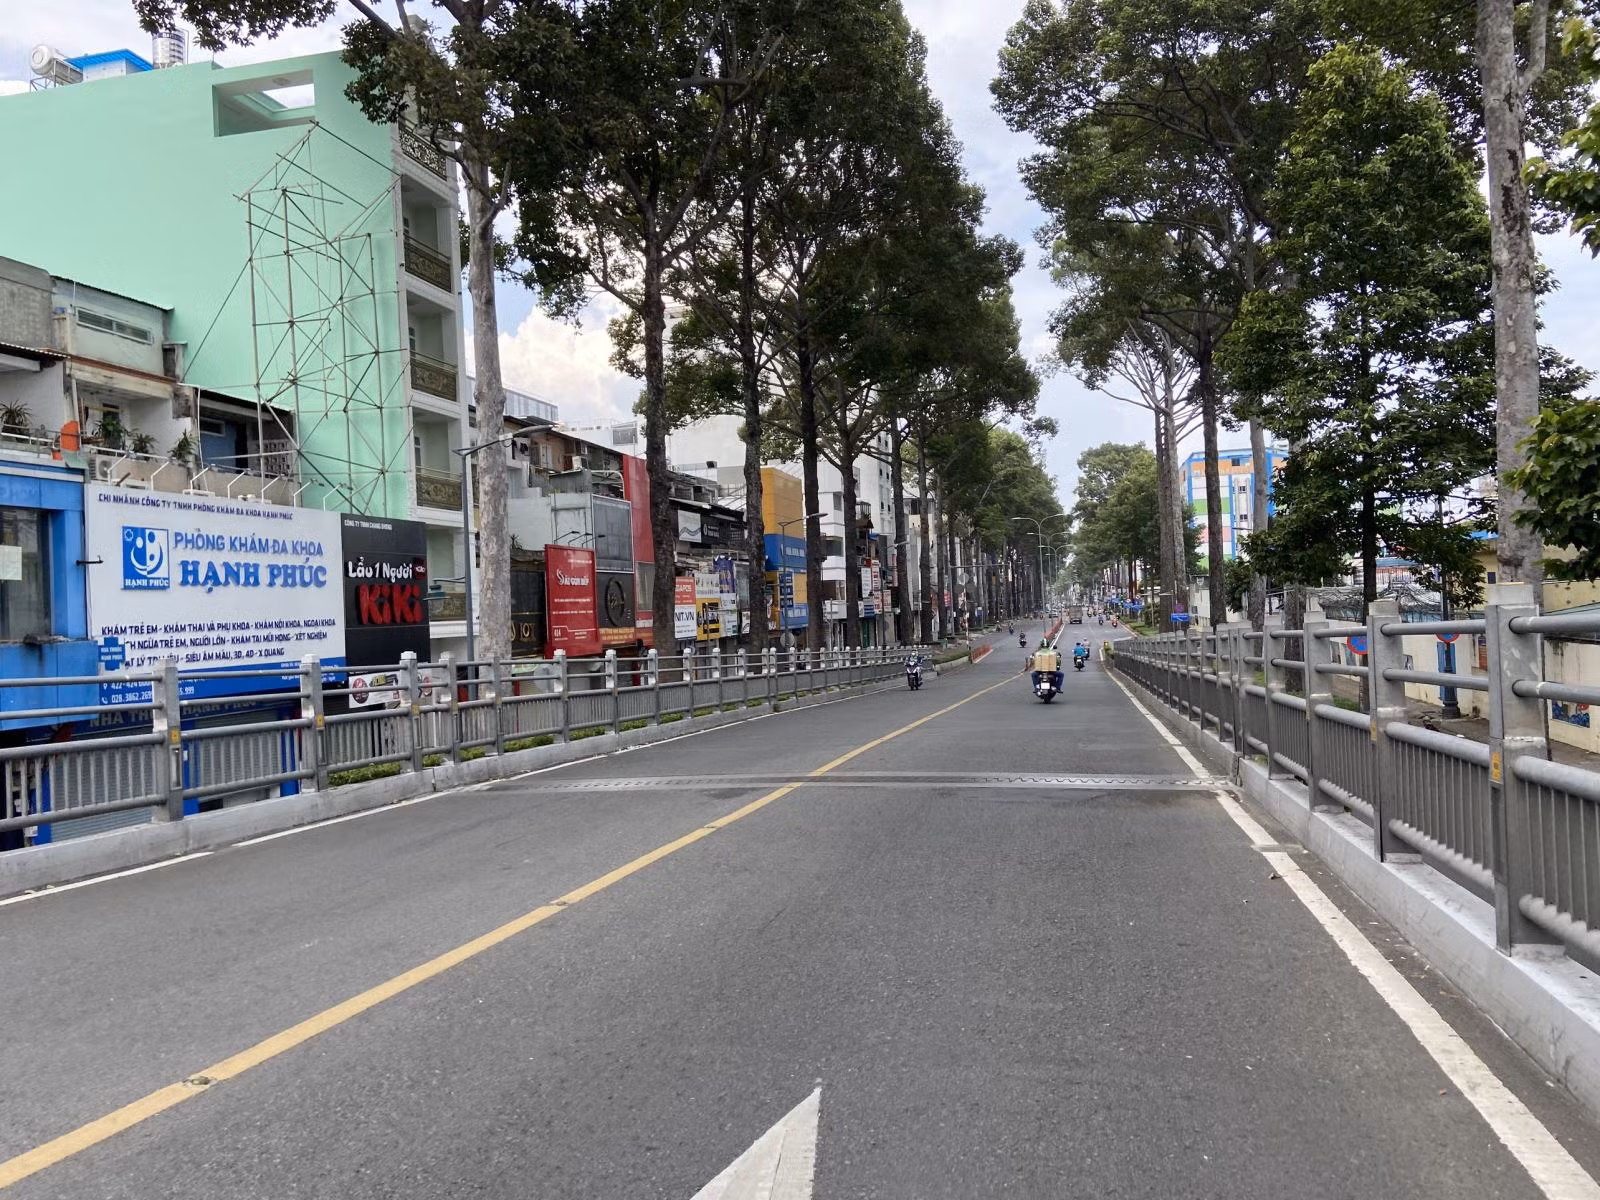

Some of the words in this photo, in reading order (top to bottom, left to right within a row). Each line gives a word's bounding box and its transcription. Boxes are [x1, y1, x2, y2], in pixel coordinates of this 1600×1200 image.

[98, 493, 111, 503] CHI
[141, 495, 161, 508] CÔNG
[161, 500, 172, 508] TY
[173, 501, 192, 510] TNHH
[246, 509, 261, 517] KHOA
[173, 528, 225, 551] PHÒNG
[229, 532, 270, 554] KHÁM
[271, 538, 289, 555] ĐA
[291, 539, 324, 557] KHOA
[179, 560, 261, 594] HẠNH
[267, 557, 328, 588] PHÚC
[374, 562, 380, 578] 1
[382, 562, 413, 583] Người
[101, 623, 128, 636] KHÁM
[129, 621, 145, 635] TRẺ
[146, 624, 158, 634] EM
[163, 621, 187, 633] KHÁM
[188, 623, 206, 632] THAI
[232, 620, 250, 631] KHOA
[254, 618, 274, 629] KHÁM
[320, 618, 336, 627] KHOA
[159, 635, 174, 648] TRẺ
[231, 633, 251, 644] KHÁM
[252, 634, 262, 643] TAI
[185, 652, 201, 663] SIÊU
[203, 650, 214, 661] ÂM
[258, 649, 263, 657] X
[264, 647, 285, 658] QUANG
